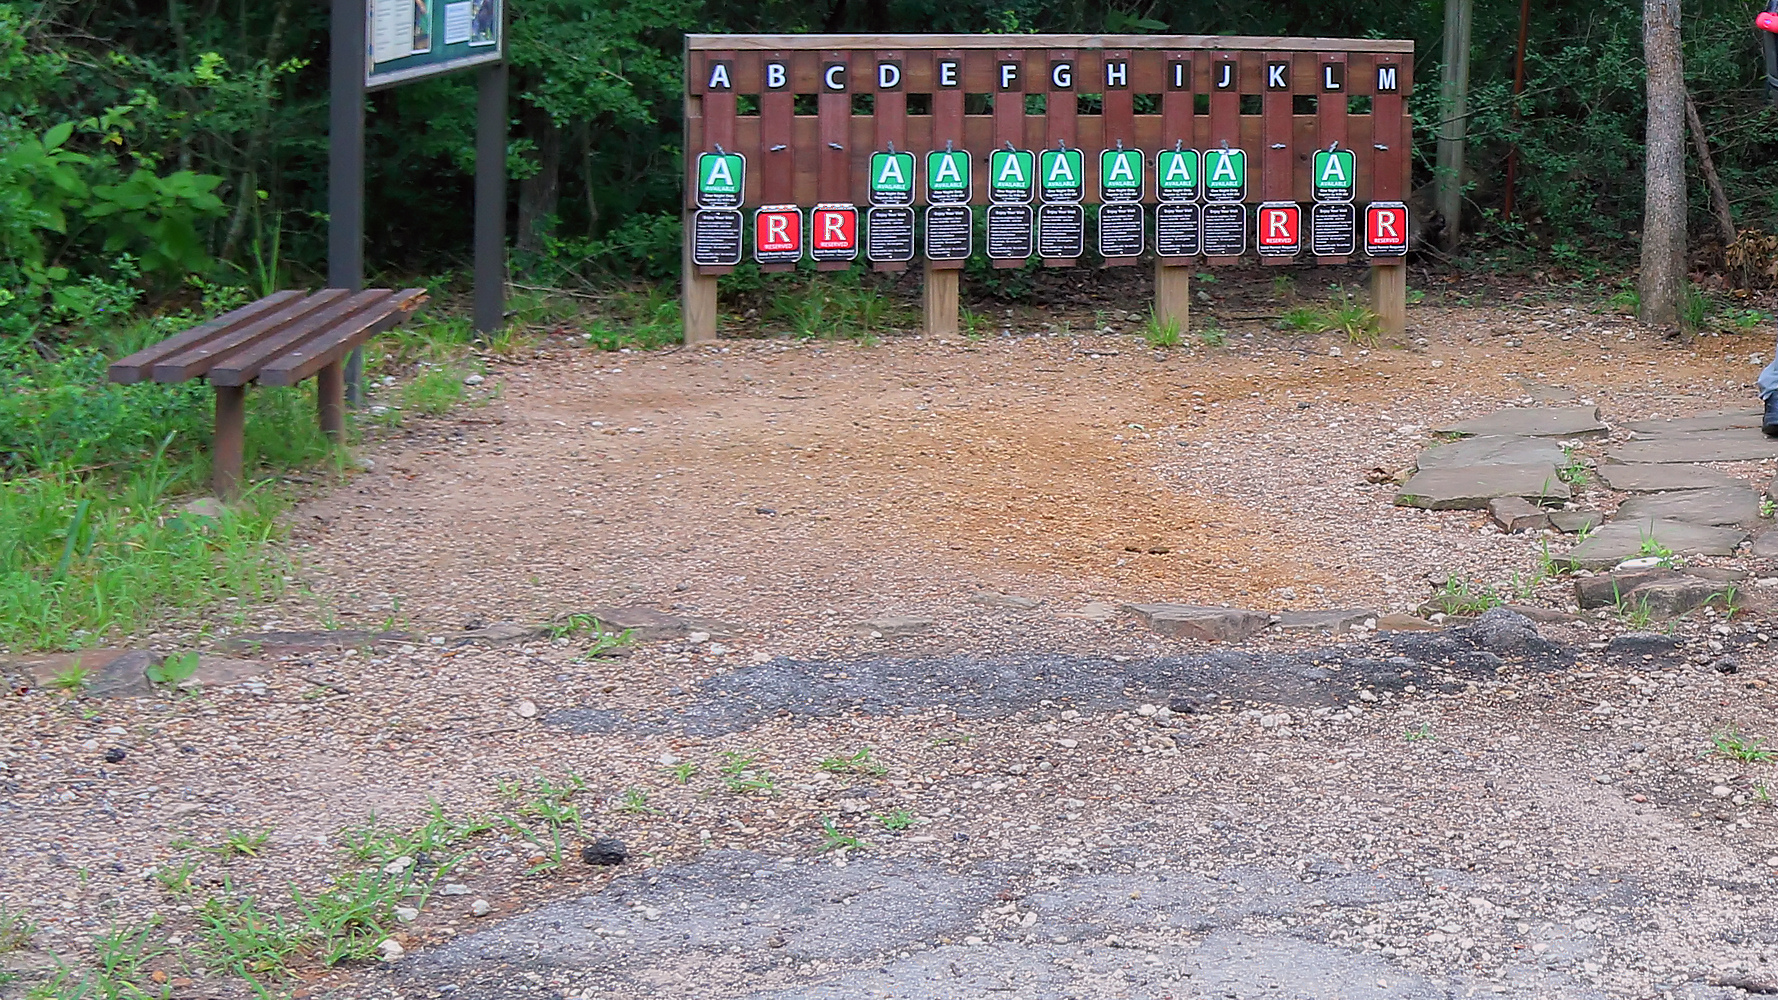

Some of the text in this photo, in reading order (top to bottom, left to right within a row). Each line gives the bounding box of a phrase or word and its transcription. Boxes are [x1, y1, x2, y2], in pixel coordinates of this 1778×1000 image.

[709, 65, 730, 88] A
[767, 64, 786, 87] B
[825, 66, 845, 89] C
[879, 65, 900, 87] D
[941, 63, 956, 85] E
[1002, 65, 1017, 87] F
[1052, 65, 1071, 87] G
[1107, 64, 1126, 86] H
[1176, 65, 1182, 86] I
[1218, 66, 1230, 87] J
[1269, 66, 1286, 87] K
[1326, 67, 1339, 88] L
[1378, 68, 1396, 89] M
[706, 158, 733, 185] A
[879, 156, 904, 183] A
[936, 155, 961, 182] A
[999, 154, 1024, 181] A
[1049, 154, 1073, 181] A
[1109, 154, 1134, 180] A
[1166, 154, 1190, 180] A
[1213, 154, 1236, 180] A
[1322, 154, 1345, 180] A
[768, 215, 790, 243] R
[824, 213, 846, 240] R
[1270, 211, 1290, 237] R
[1378, 211, 1397, 237] R
